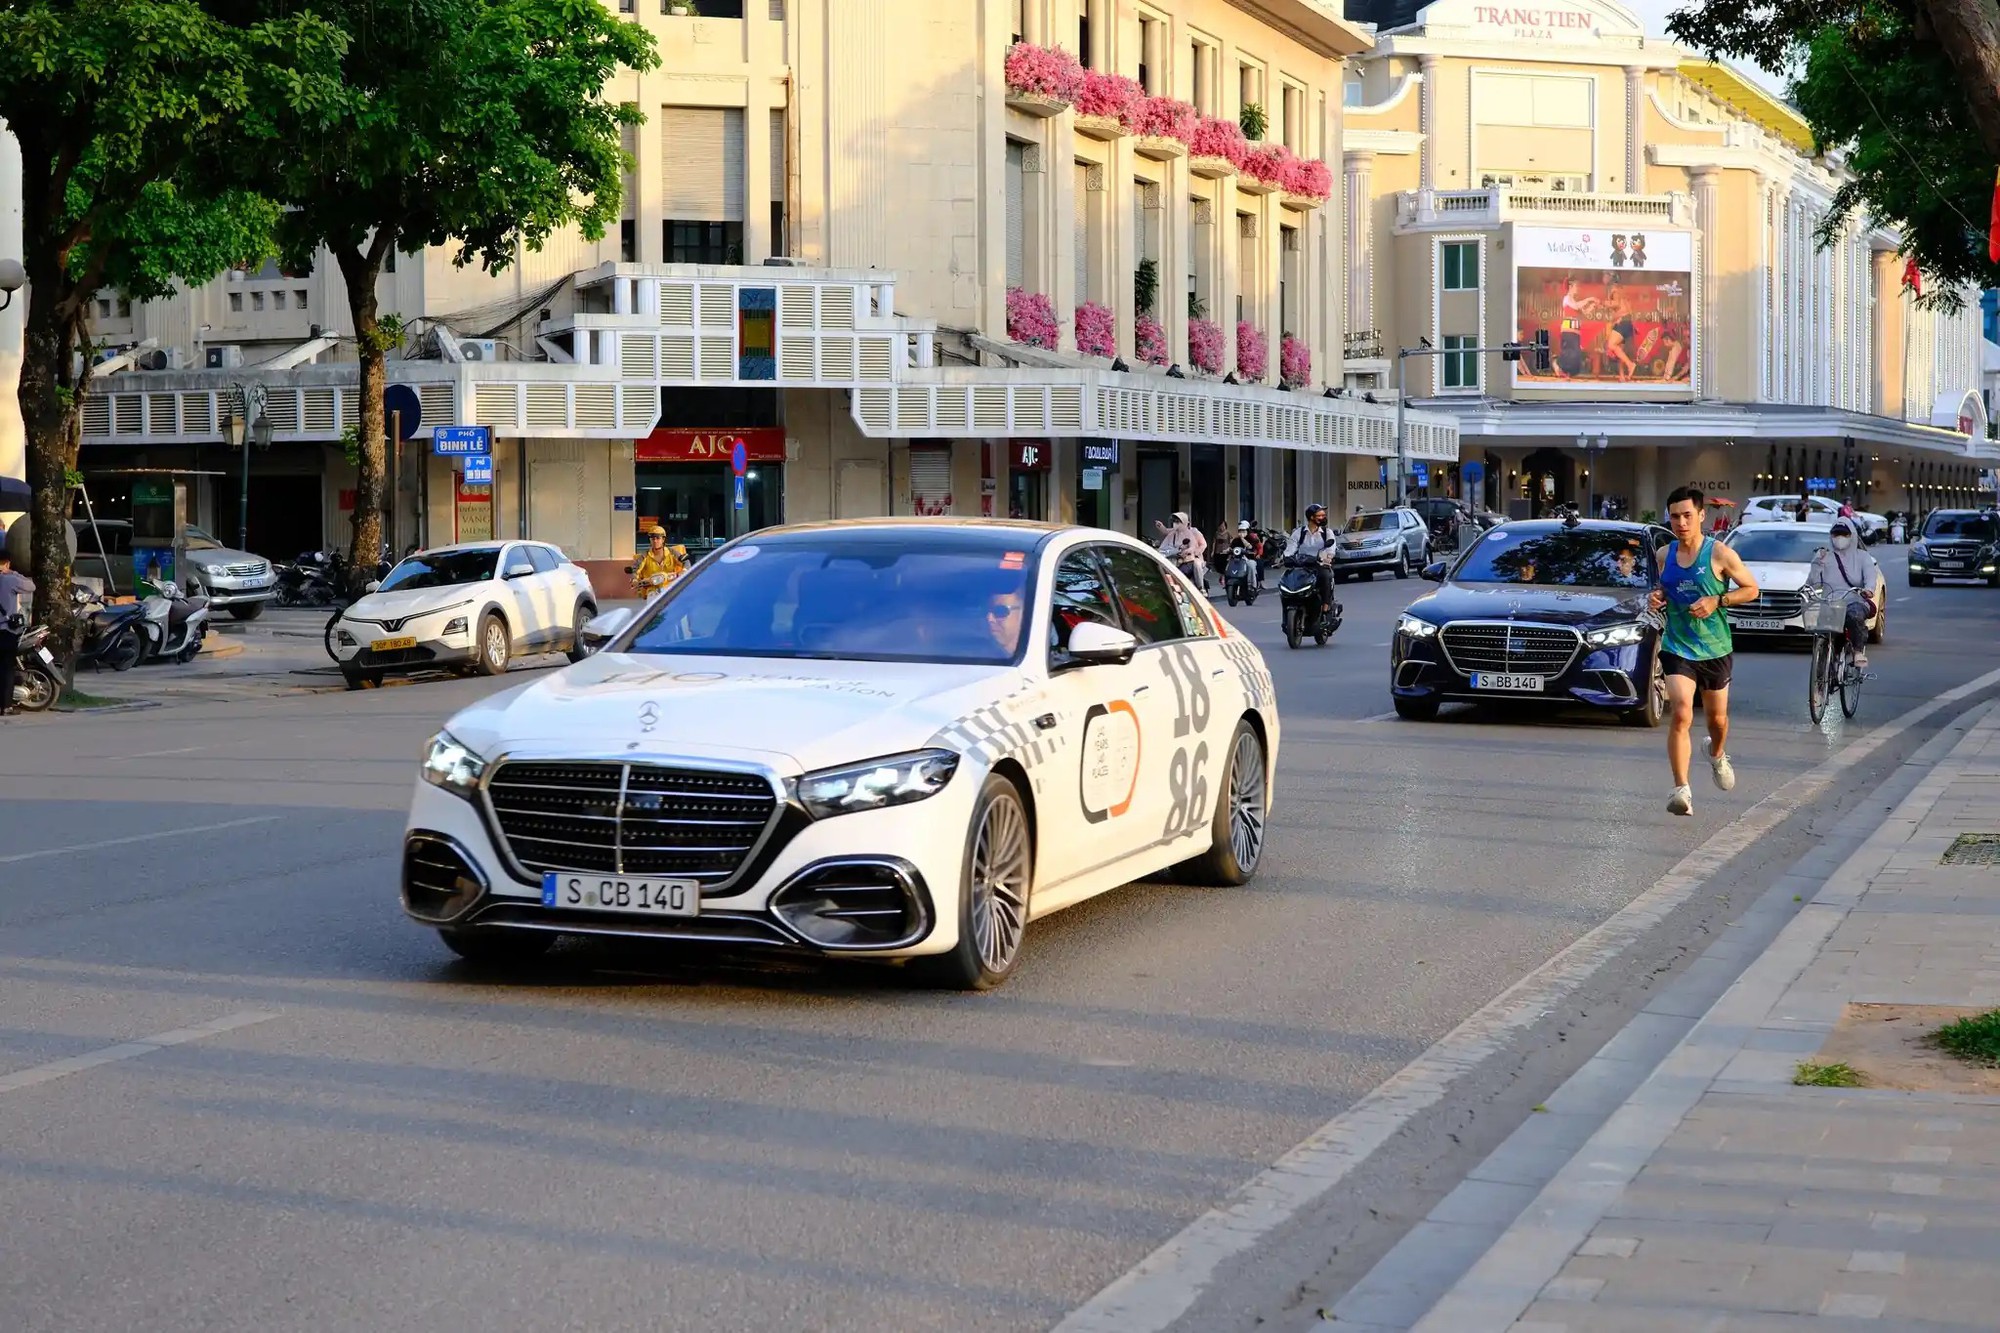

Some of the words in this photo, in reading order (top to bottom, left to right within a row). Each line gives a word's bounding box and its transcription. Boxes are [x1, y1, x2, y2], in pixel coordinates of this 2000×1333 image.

[1474, 6, 1540, 26] TRANG
[1545, 11, 1591, 28] TIEN
[1514, 28, 1552, 39] PLAZA
[688, 435, 735, 457] AJC
[1022, 446, 1038, 466] AJC
[1690, 480, 1730, 490] GUCCI
[1157, 643, 1211, 739] 18
[1482, 675, 1489, 687] S
[1162, 740, 1210, 839] 86
[567, 879, 581, 903] S
[600, 881, 630, 907] CB
[637, 883, 684, 910] 140
